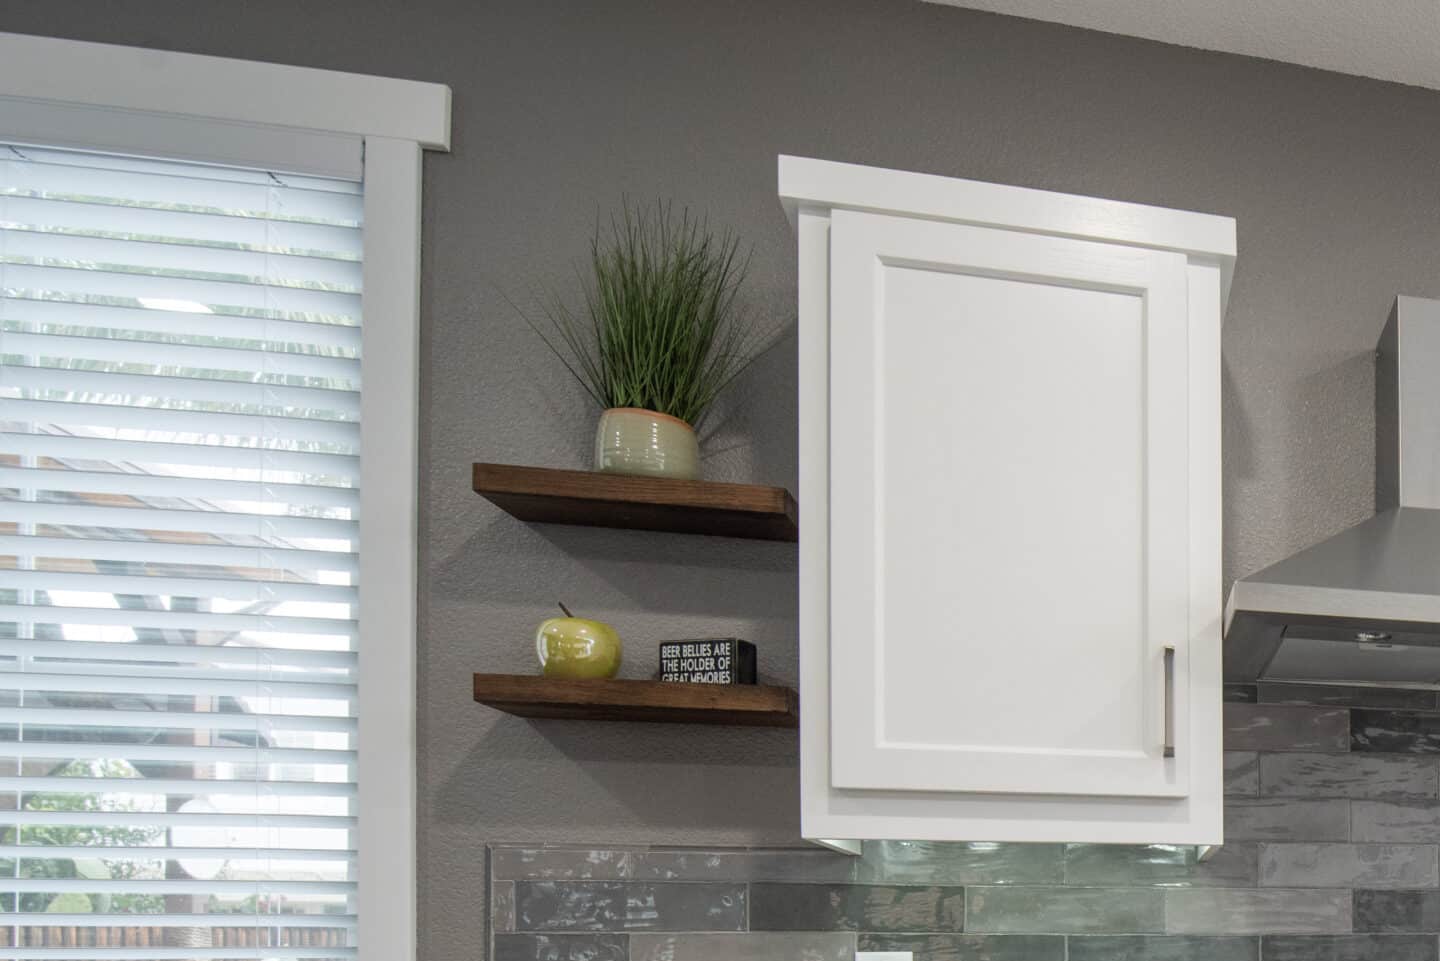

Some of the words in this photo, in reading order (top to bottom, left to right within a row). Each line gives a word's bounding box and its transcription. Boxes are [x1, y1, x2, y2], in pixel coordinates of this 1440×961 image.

[662, 645, 680, 659] BEER
[682, 643, 712, 658] BELLIES
[713, 642, 731, 656] ARE
[662, 658, 679, 673] THE
[680, 657, 716, 672] HOLDER
[717, 656, 731, 670] OF
[662, 672, 689, 682] GREAT
[690, 671, 731, 684] MEMORIES
